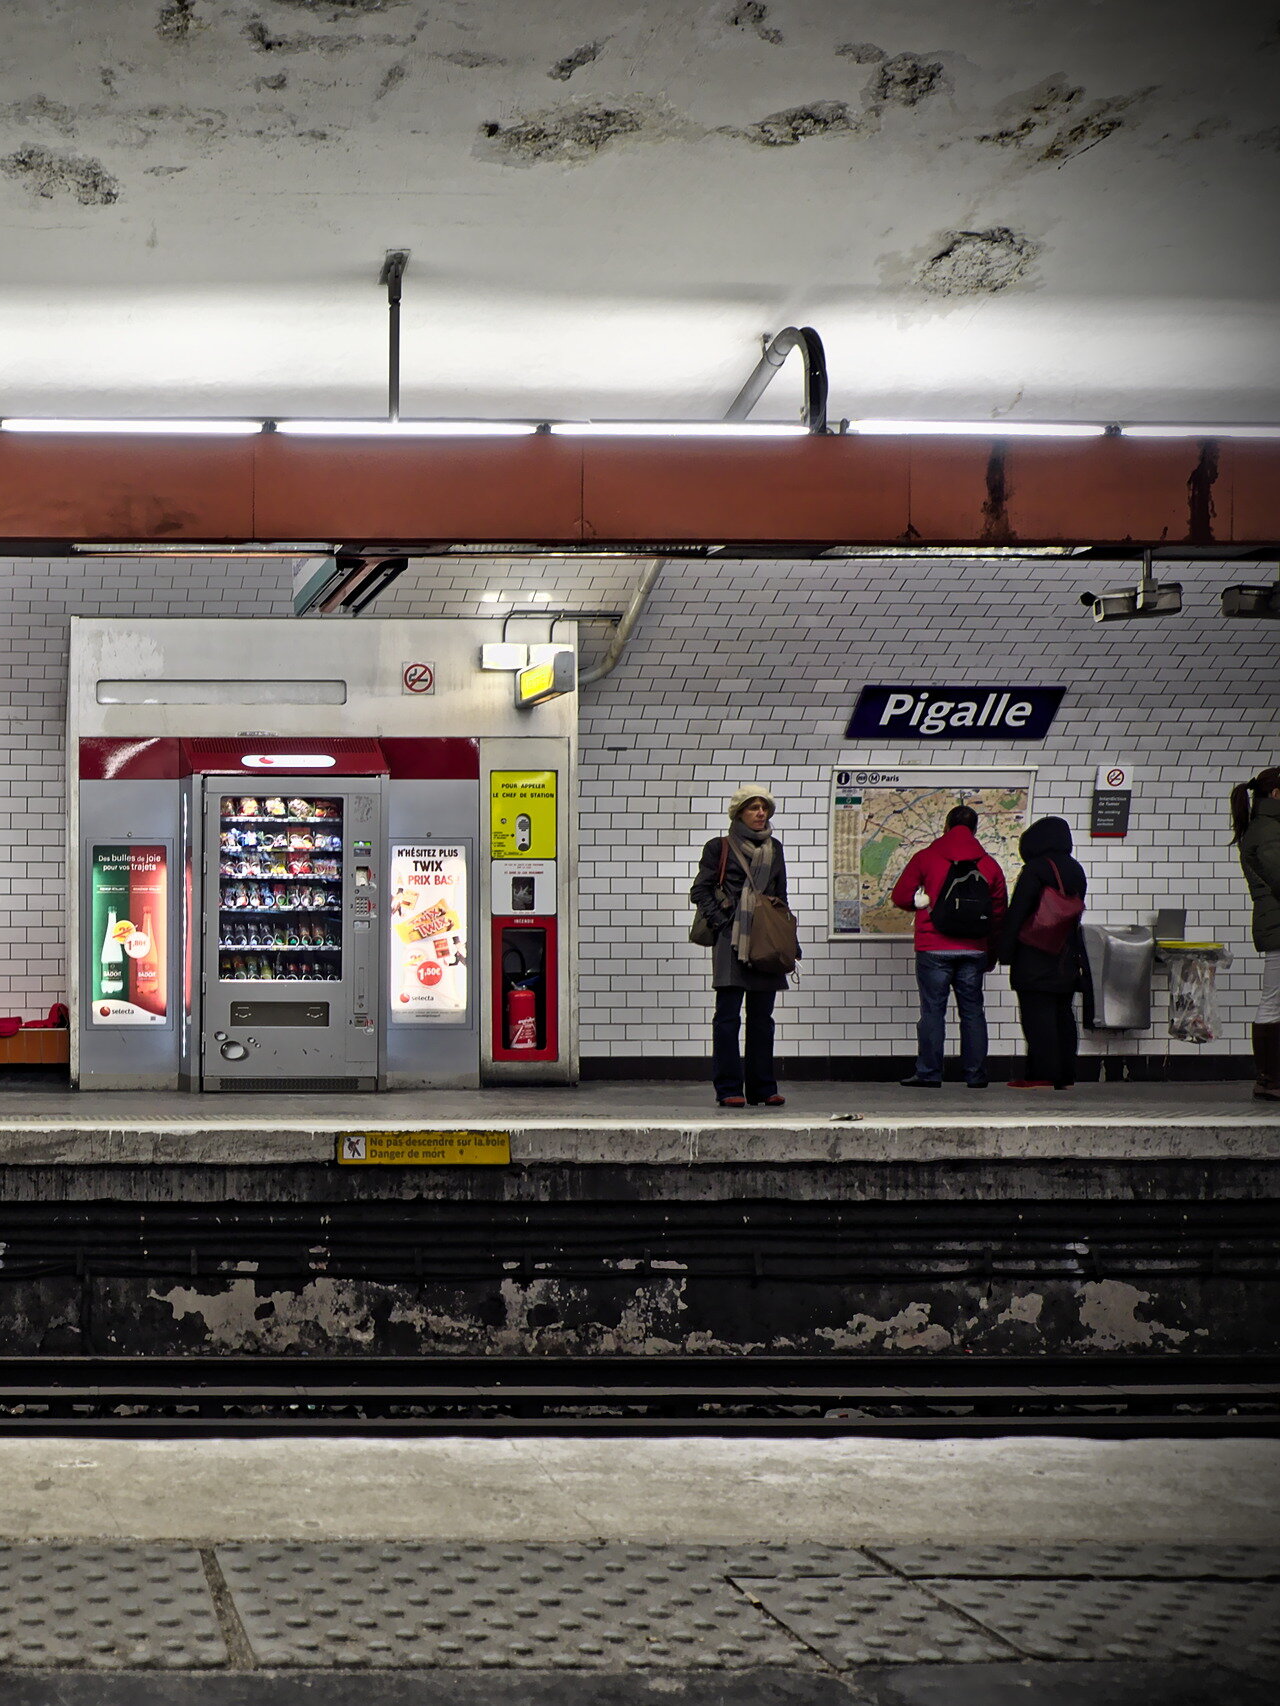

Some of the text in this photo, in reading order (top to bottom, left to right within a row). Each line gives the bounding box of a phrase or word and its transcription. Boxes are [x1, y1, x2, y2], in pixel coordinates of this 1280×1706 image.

[878, 692, 1033, 735] Pigalle
[397, 847, 458, 857] N'HÉSITEZ PLUS
[111, 854, 136, 862] bulles
[146, 854, 161, 863] joie
[131, 863, 157, 872] trajets
[413, 860, 443, 872] TWIX
[408, 875, 431, 886] PRIX
[434, 875, 454, 886] BAS
[415, 917, 448, 938] TWIX
[370, 1137, 383, 1146] Ne
[386, 1139, 403, 1149] pas
[406, 1136, 454, 1147] descendre
[457, 1138, 471, 1147] sur
[474, 1136, 483, 1147] la
[370, 1149, 446, 1161] Danger de mort
